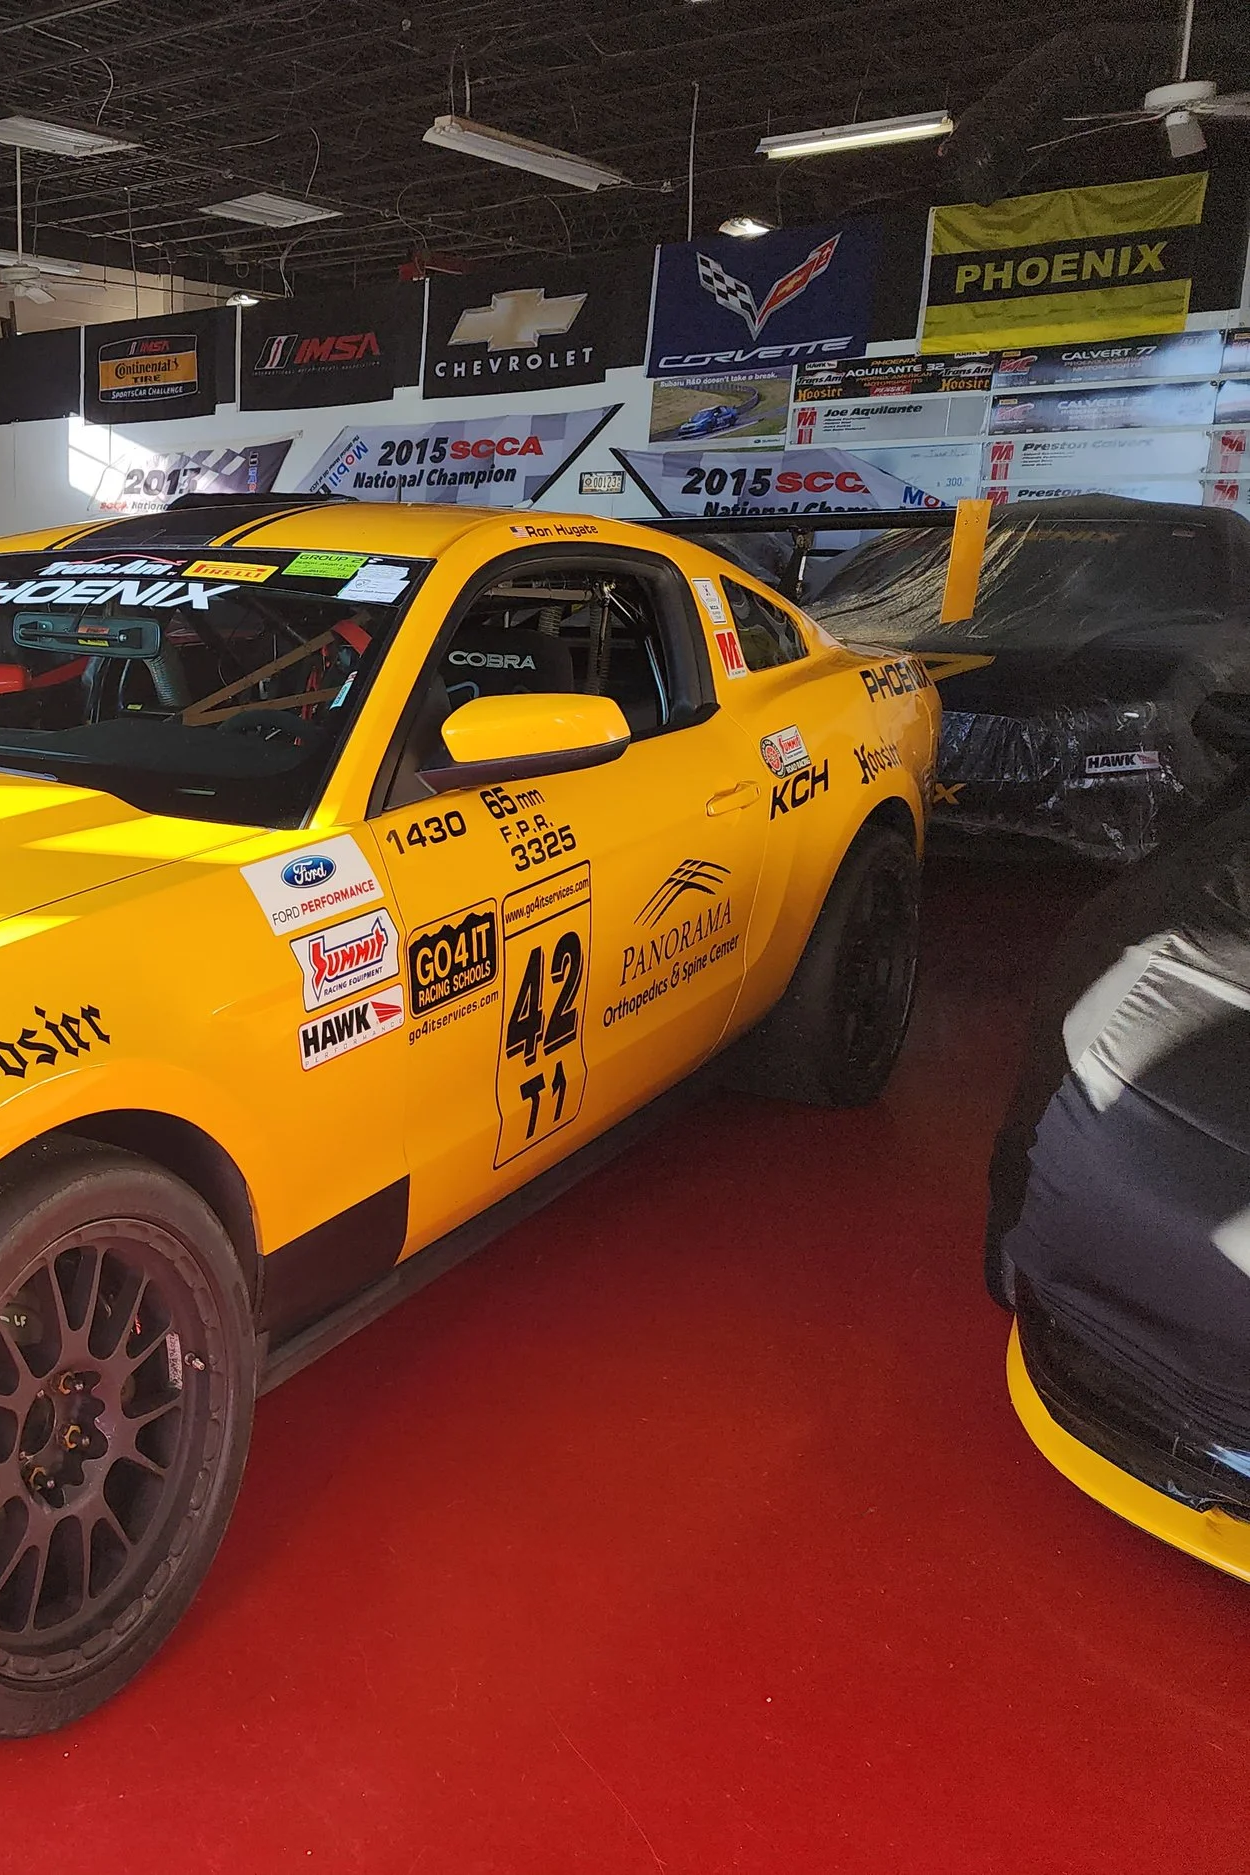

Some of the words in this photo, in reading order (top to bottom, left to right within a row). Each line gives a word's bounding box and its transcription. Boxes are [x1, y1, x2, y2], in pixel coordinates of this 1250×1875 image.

[954, 241, 1170, 295] PHOENIX
[293, 332, 381, 364] IMSA
[434, 346, 595, 379] CHEVROLET
[658, 336, 854, 370] CORVETTE
[870, 358, 918, 366] PHOENIX
[1061, 348, 1135, 361] CALVERT
[1136, 345, 1157, 355] 77
[115, 359, 171, 380] Continental
[131, 374, 162, 384] TIRE
[660, 380, 685, 388] Subaru
[686, 378, 701, 386] R&D
[703, 376, 730, 384] doesn't
[754, 371, 778, 380] break.
[846, 365, 923, 377] AQUILANTE
[926, 362, 945, 372] 32
[797, 386, 843, 401] Hoosier
[937, 378, 990, 392] Hoosier
[823, 408, 848, 418] Joe
[850, 404, 923, 418] Aquilante
[378, 437, 449, 466] 2015
[450, 435, 544, 460] SCCA
[1022, 441, 1086, 452] Preston
[352, 468, 425, 489] National
[426, 463, 517, 491] Champion
[593, 476, 617, 488] 00123
[682, 467, 773, 496] 2015
[774, 469, 871, 494] SCC
[131, 501, 170, 512] Nationa
[525, 526, 553, 537] Ron
[553, 524, 599, 538] Hugate
[194, 563, 268, 581] PIRELLI
[299, 554, 348, 562] GROUP
[448, 650, 536, 671] COBRA
[859, 659, 932, 702] PHOENIX
[1087, 755, 1136, 770] HAWK
[479, 786, 519, 820] 65
[517, 788, 546, 810] mm
[769, 758, 829, 821] KCH
[385, 810, 469, 856] 1430
[499, 814, 554, 844] F.P.R.
[510, 825, 577, 872] 3325
[293, 859, 327, 884] Ford
[272, 906, 300, 926] FORD
[301, 879, 375, 915] PERFORMANCE
[504, 877, 590, 925] www.go4itservices.com
[309, 920, 387, 990] SUMMIT
[620, 897, 732, 986] PANORAMA
[323, 982, 348, 996] RACING
[348, 967, 383, 986] EQUIPMENT
[418, 980, 450, 1008] RACING
[452, 960, 492, 992] SCHOOLS
[603, 977, 669, 1028] Orthopedics
[669, 964, 681, 989] &
[681, 952, 708, 981] Spine
[707, 933, 740, 967] Center
[504, 931, 585, 1066] 42
[302, 1002, 371, 1058] HAWK
[408, 990, 499, 1046] go4itservices.com
[305, 1018, 403, 1067] PERFORMANCE
[519, 1060, 568, 1140] T1
